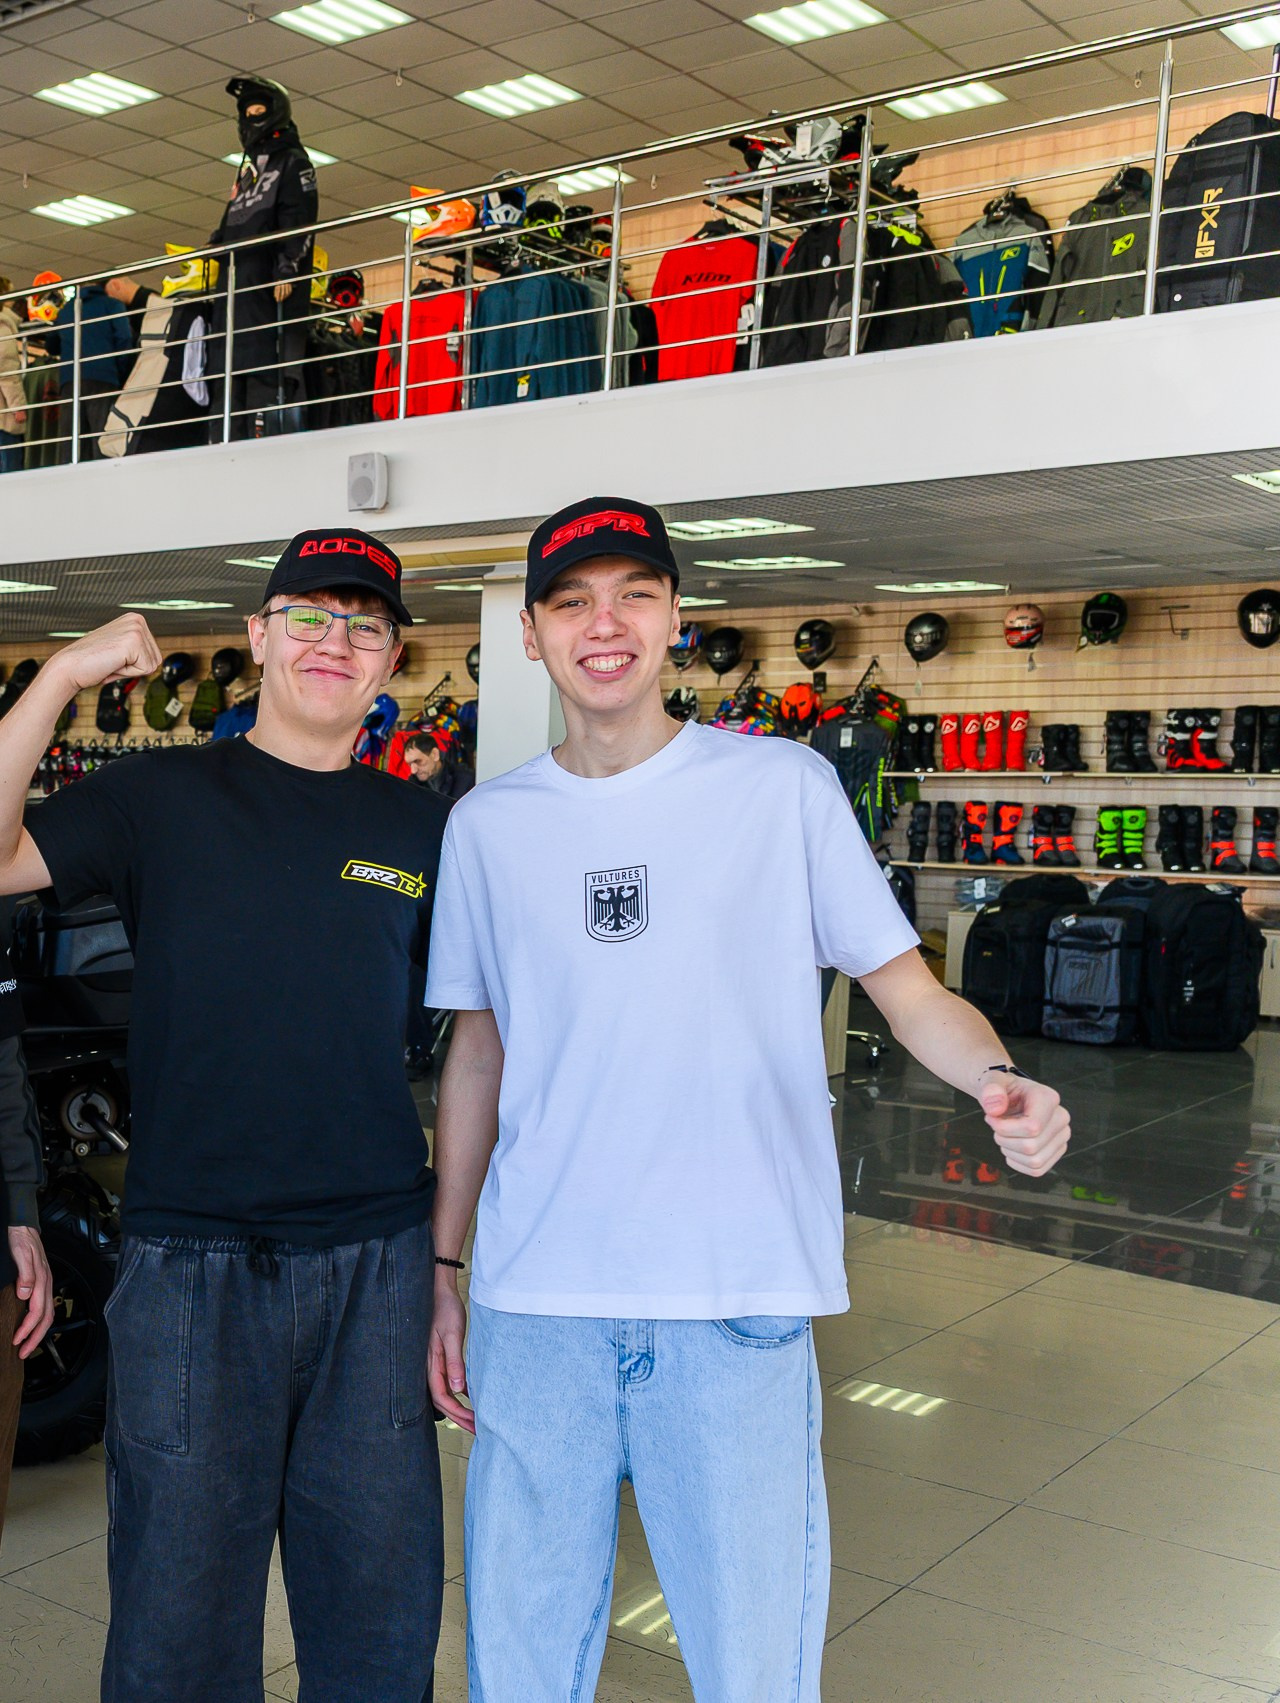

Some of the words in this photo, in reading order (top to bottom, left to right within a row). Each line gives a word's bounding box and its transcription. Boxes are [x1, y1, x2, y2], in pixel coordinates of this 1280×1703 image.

[1196, 187, 1223, 248] FXR
[541, 510, 651, 559] SPR
[299, 538, 397, 580] AODES
[591, 869, 640, 884] VULTURES
